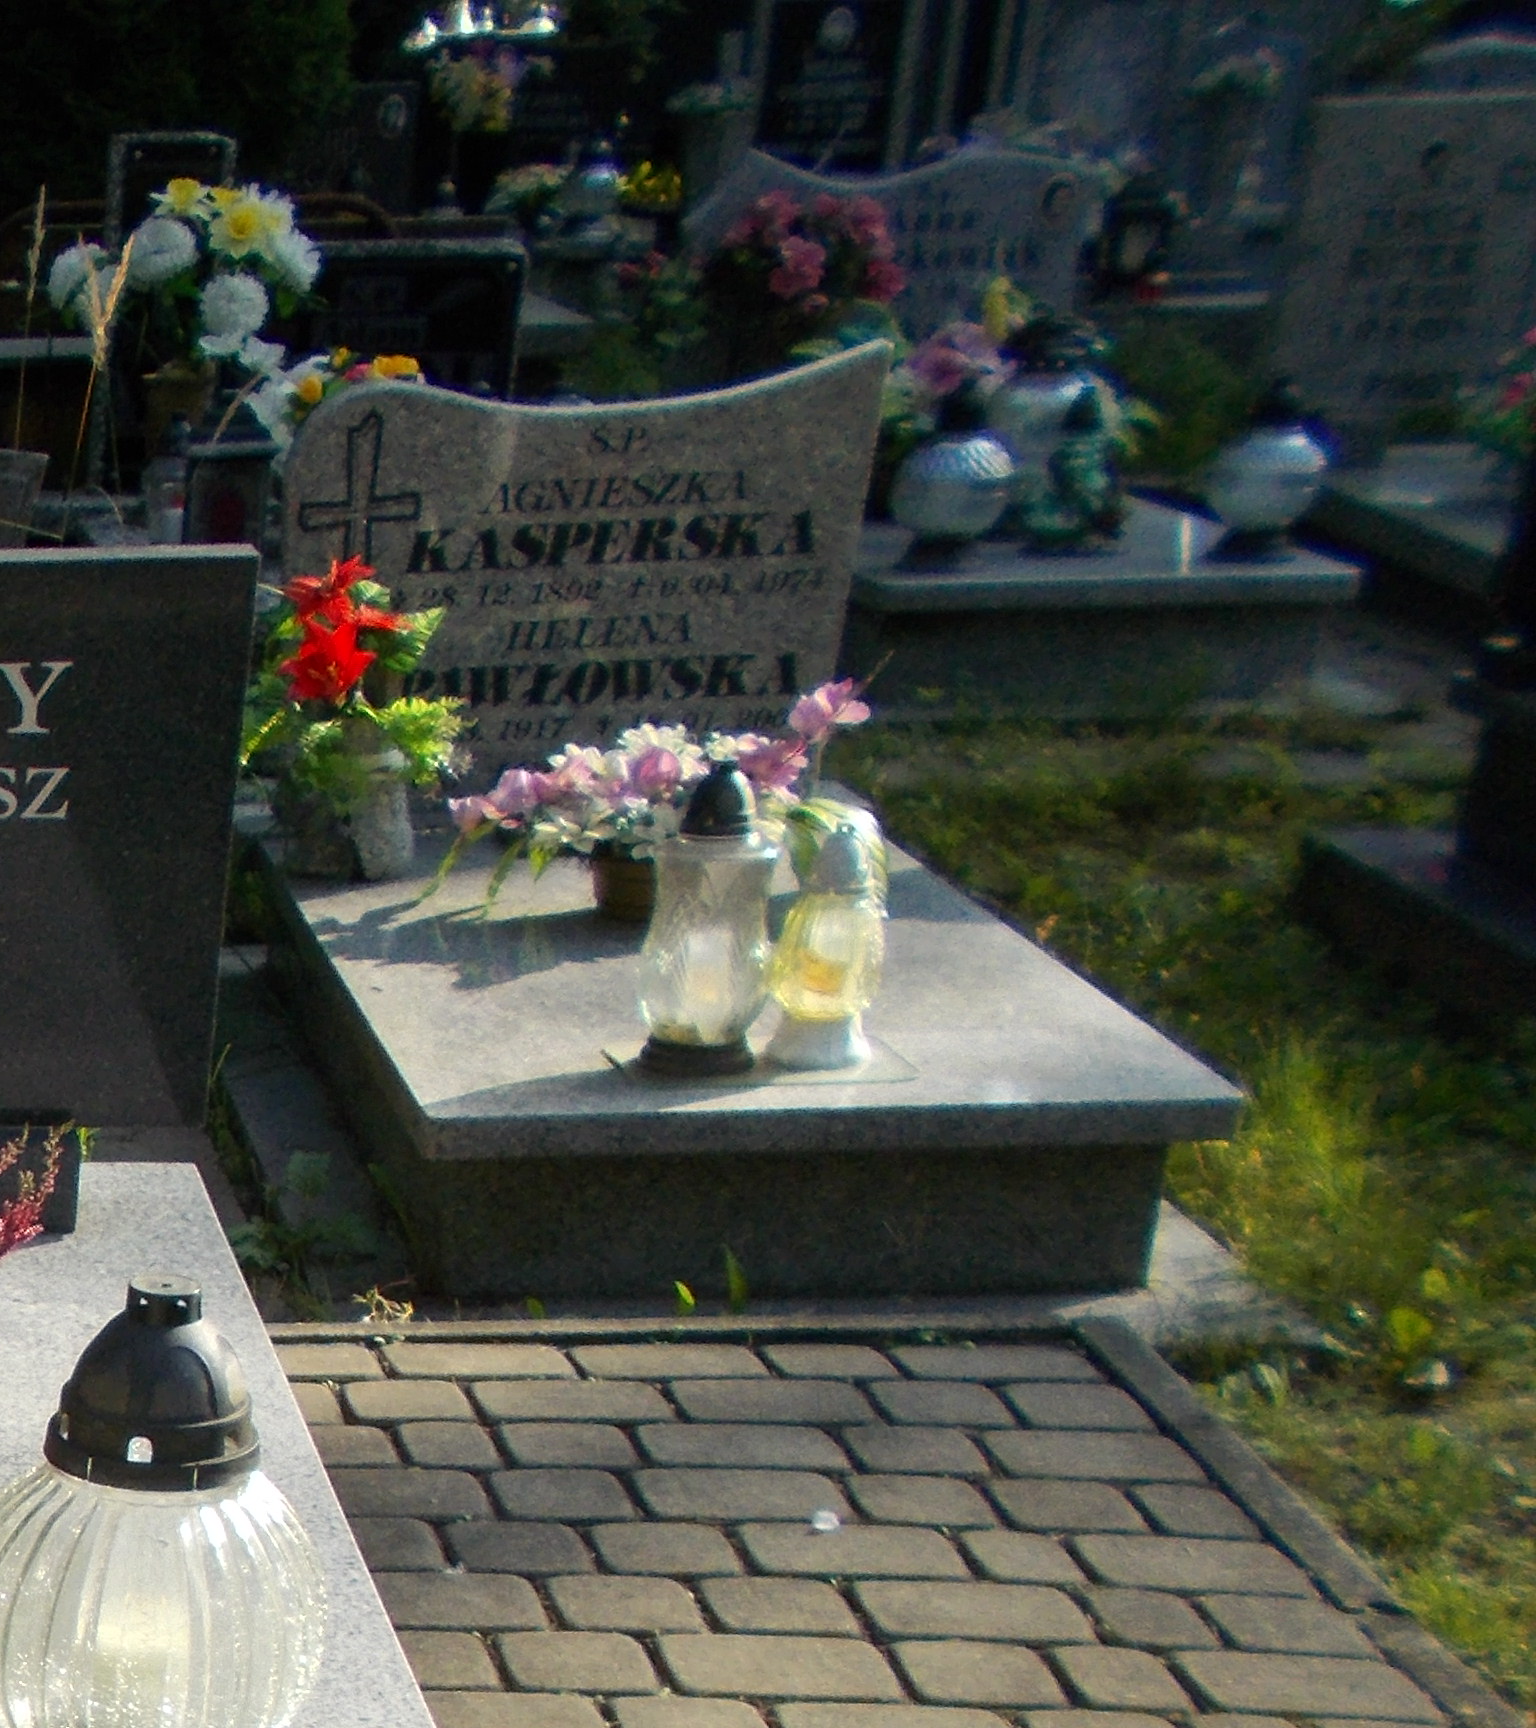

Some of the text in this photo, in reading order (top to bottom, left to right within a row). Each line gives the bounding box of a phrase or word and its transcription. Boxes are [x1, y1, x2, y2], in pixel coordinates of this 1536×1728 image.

[477, 468, 748, 514] AGNIESZKA
[407, 508, 817, 573] KASPERSKA
[506, 612, 693, 653] HELENA
[400, 650, 799, 707] PAWŁOWSKA
